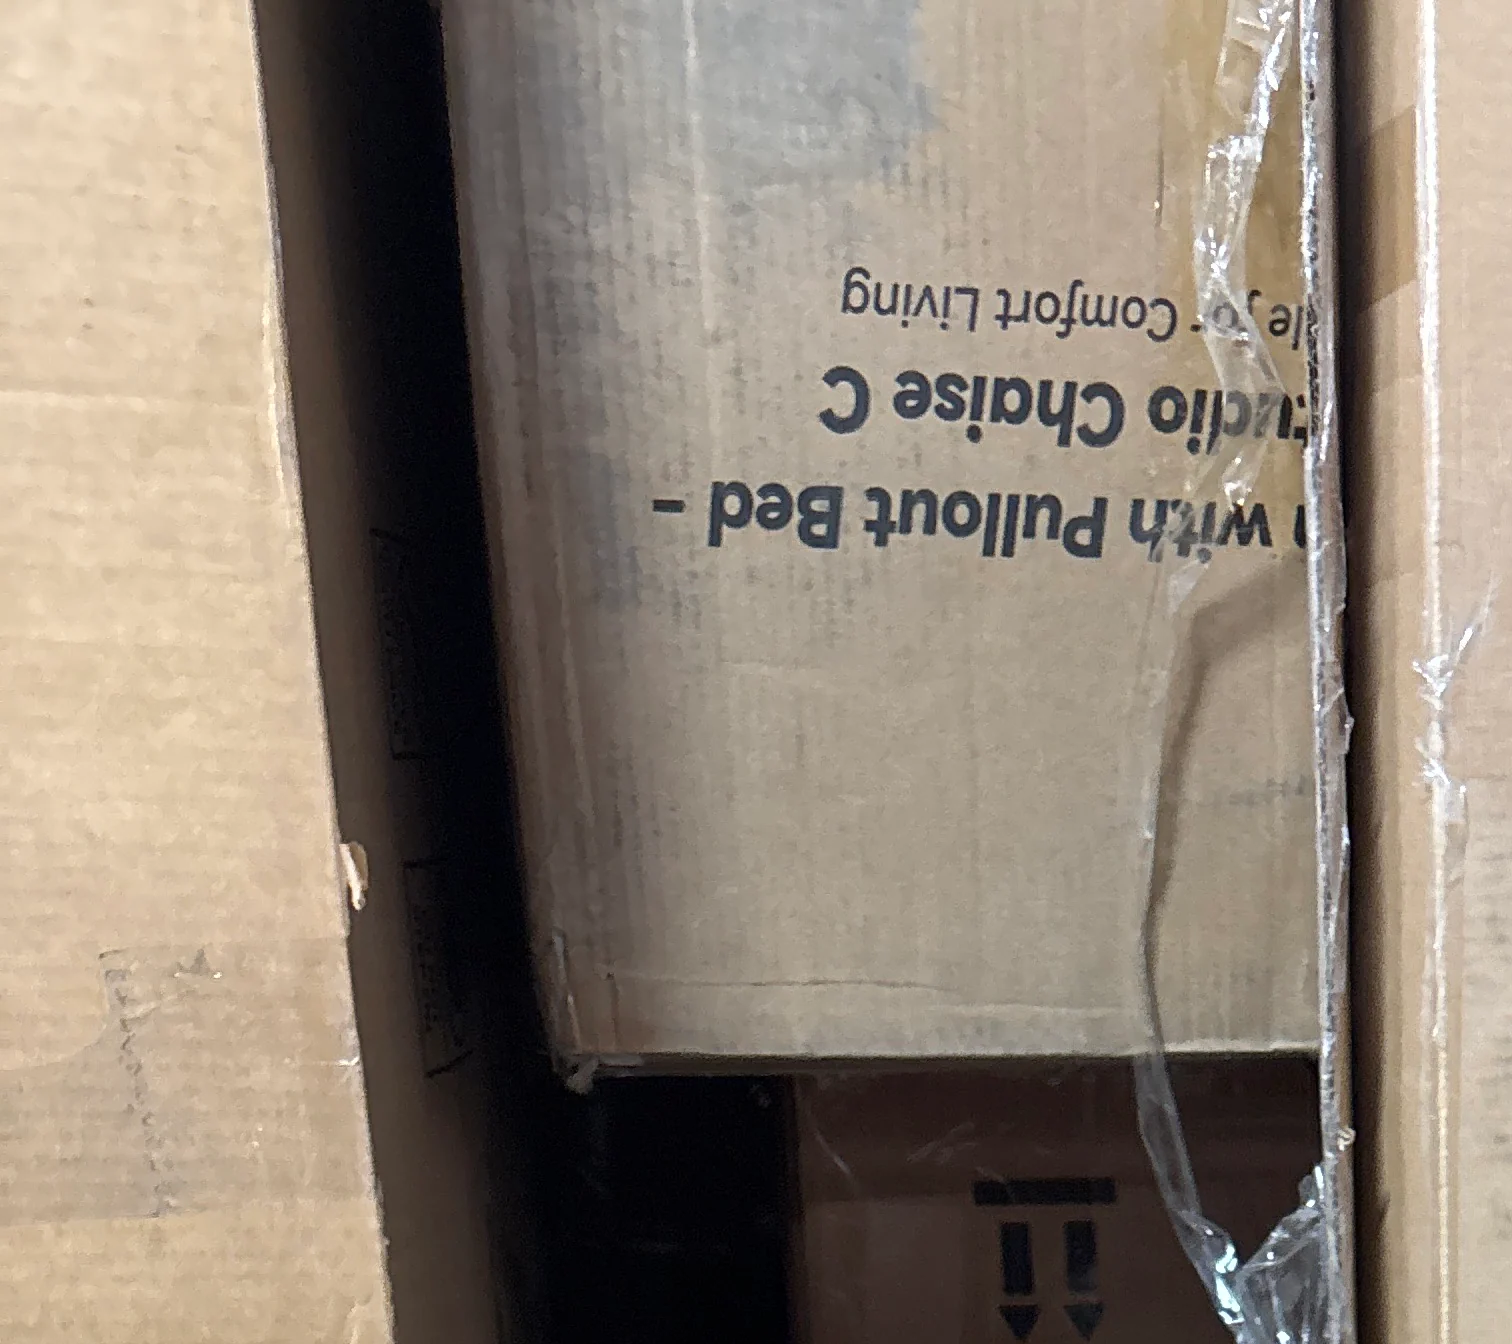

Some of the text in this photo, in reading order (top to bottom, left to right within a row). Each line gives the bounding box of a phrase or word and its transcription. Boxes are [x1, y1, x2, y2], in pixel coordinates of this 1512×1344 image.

[843, 267, 979, 332] Living
[995, 280, 1178, 343] Comfort
[820, 367, 871, 435] C
[894, 371, 1125, 448] Chaise
[708, 482, 843, 550] Bed
[864, 486, 1109, 559] Pullout
[1130, 499, 1272, 565] with
